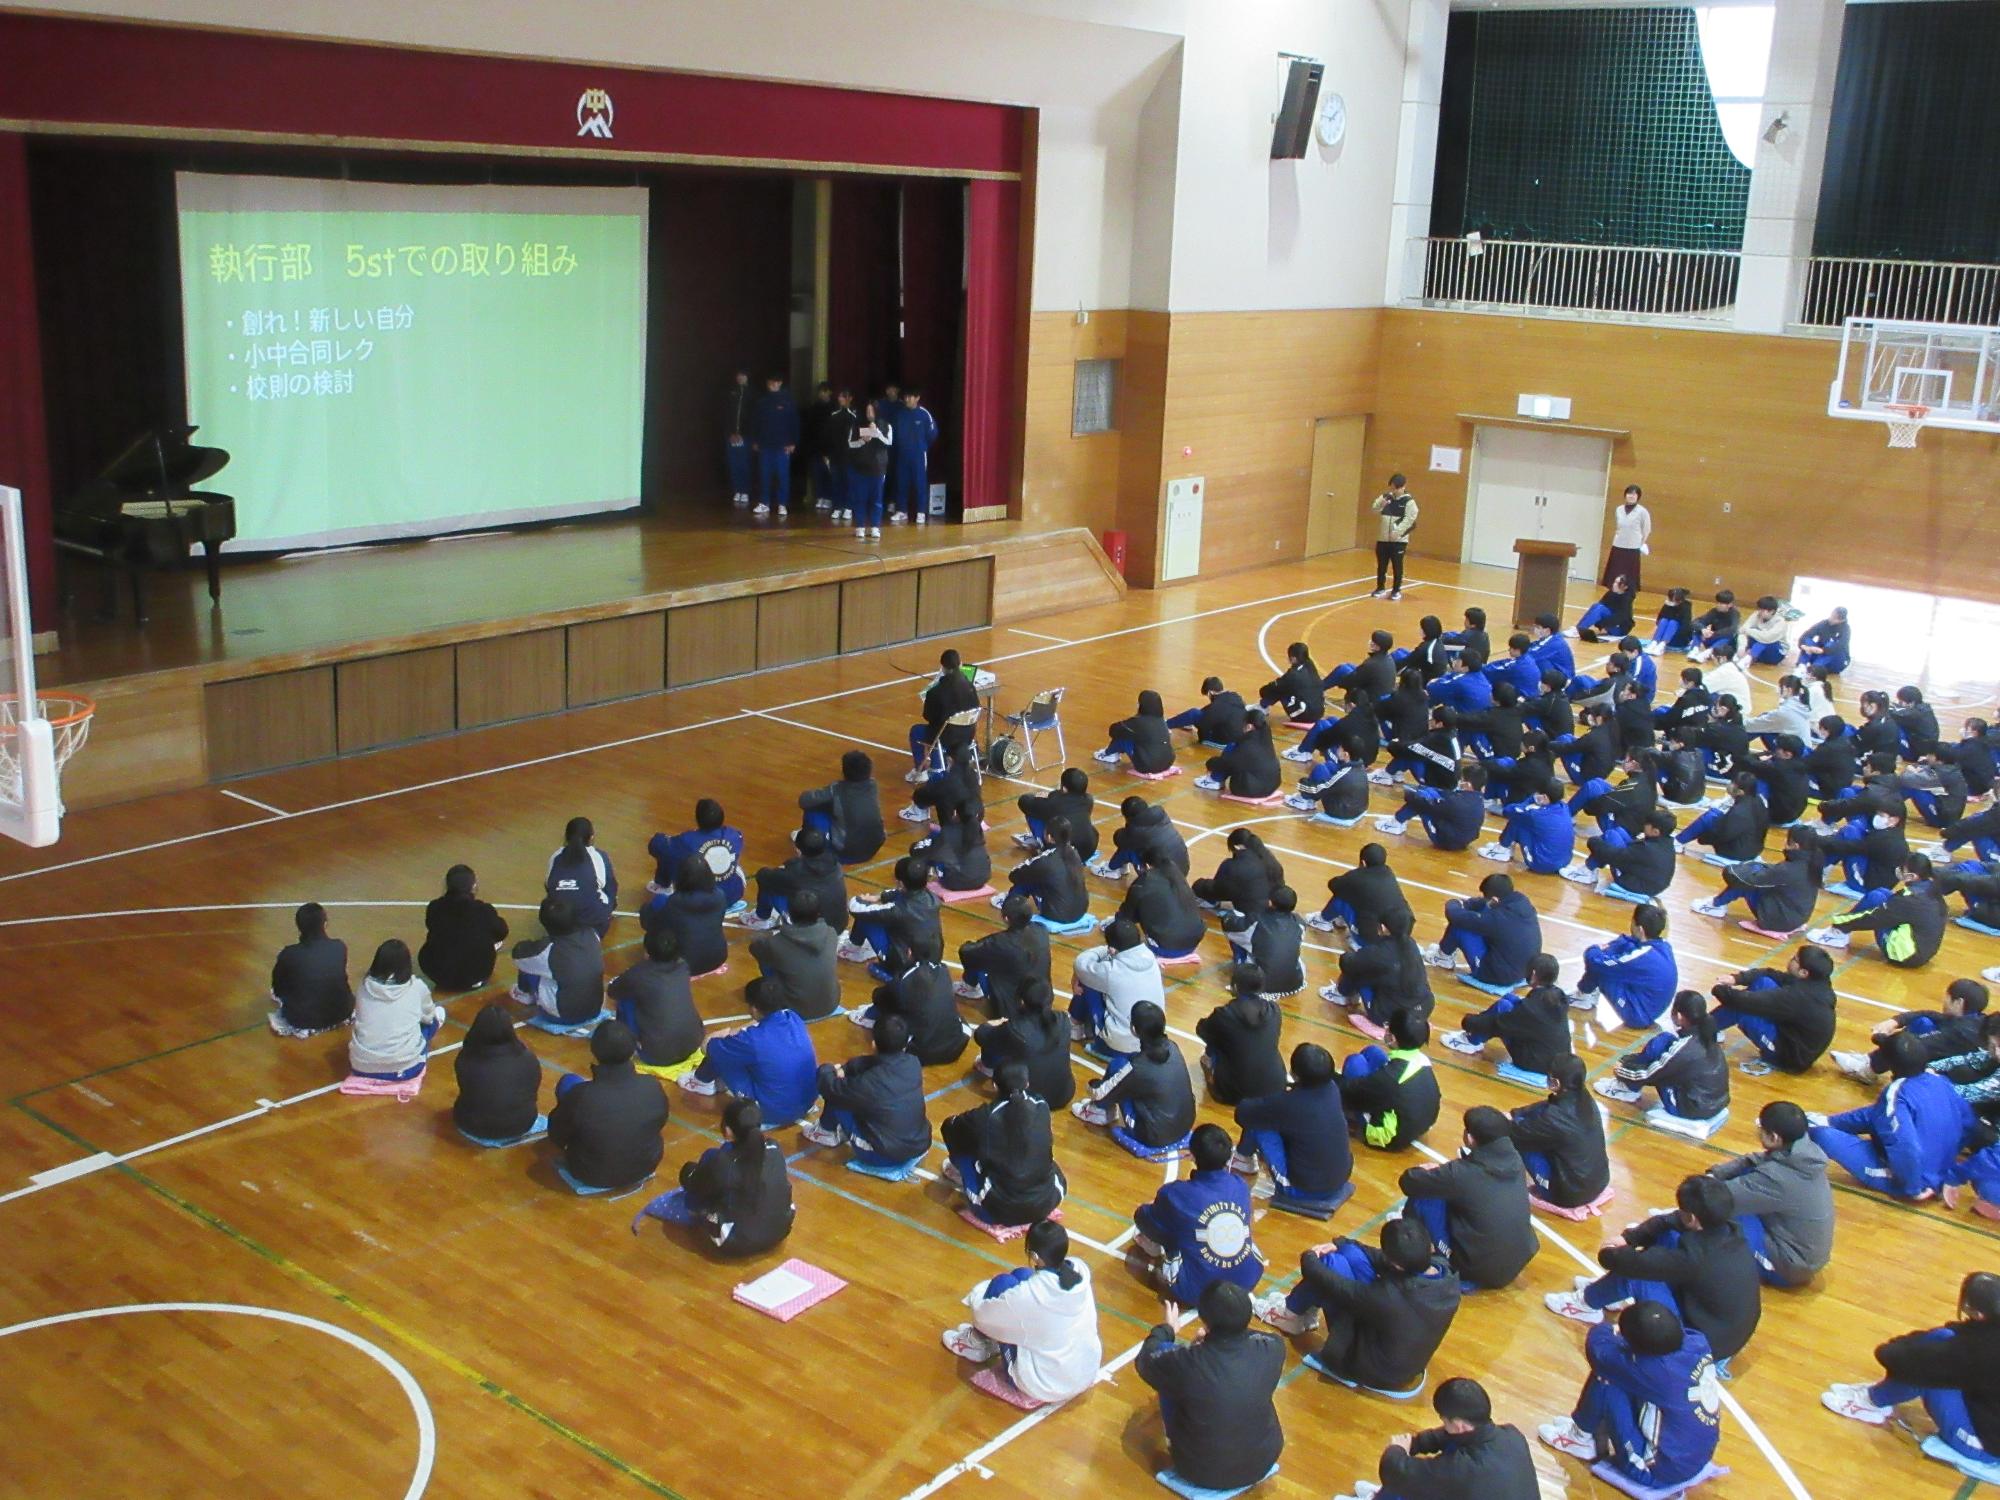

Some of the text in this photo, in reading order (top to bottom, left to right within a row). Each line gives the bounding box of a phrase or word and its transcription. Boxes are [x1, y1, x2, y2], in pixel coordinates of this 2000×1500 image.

[209, 241, 578, 283] 執行部 5stでの取り組み
[244, 337, 375, 371] 小中合同レク
[246, 368, 355, 401] 校則の検討
[1198, 1201, 1229, 1225] INFINITY
[1200, 1246, 1220, 1267] Don't
